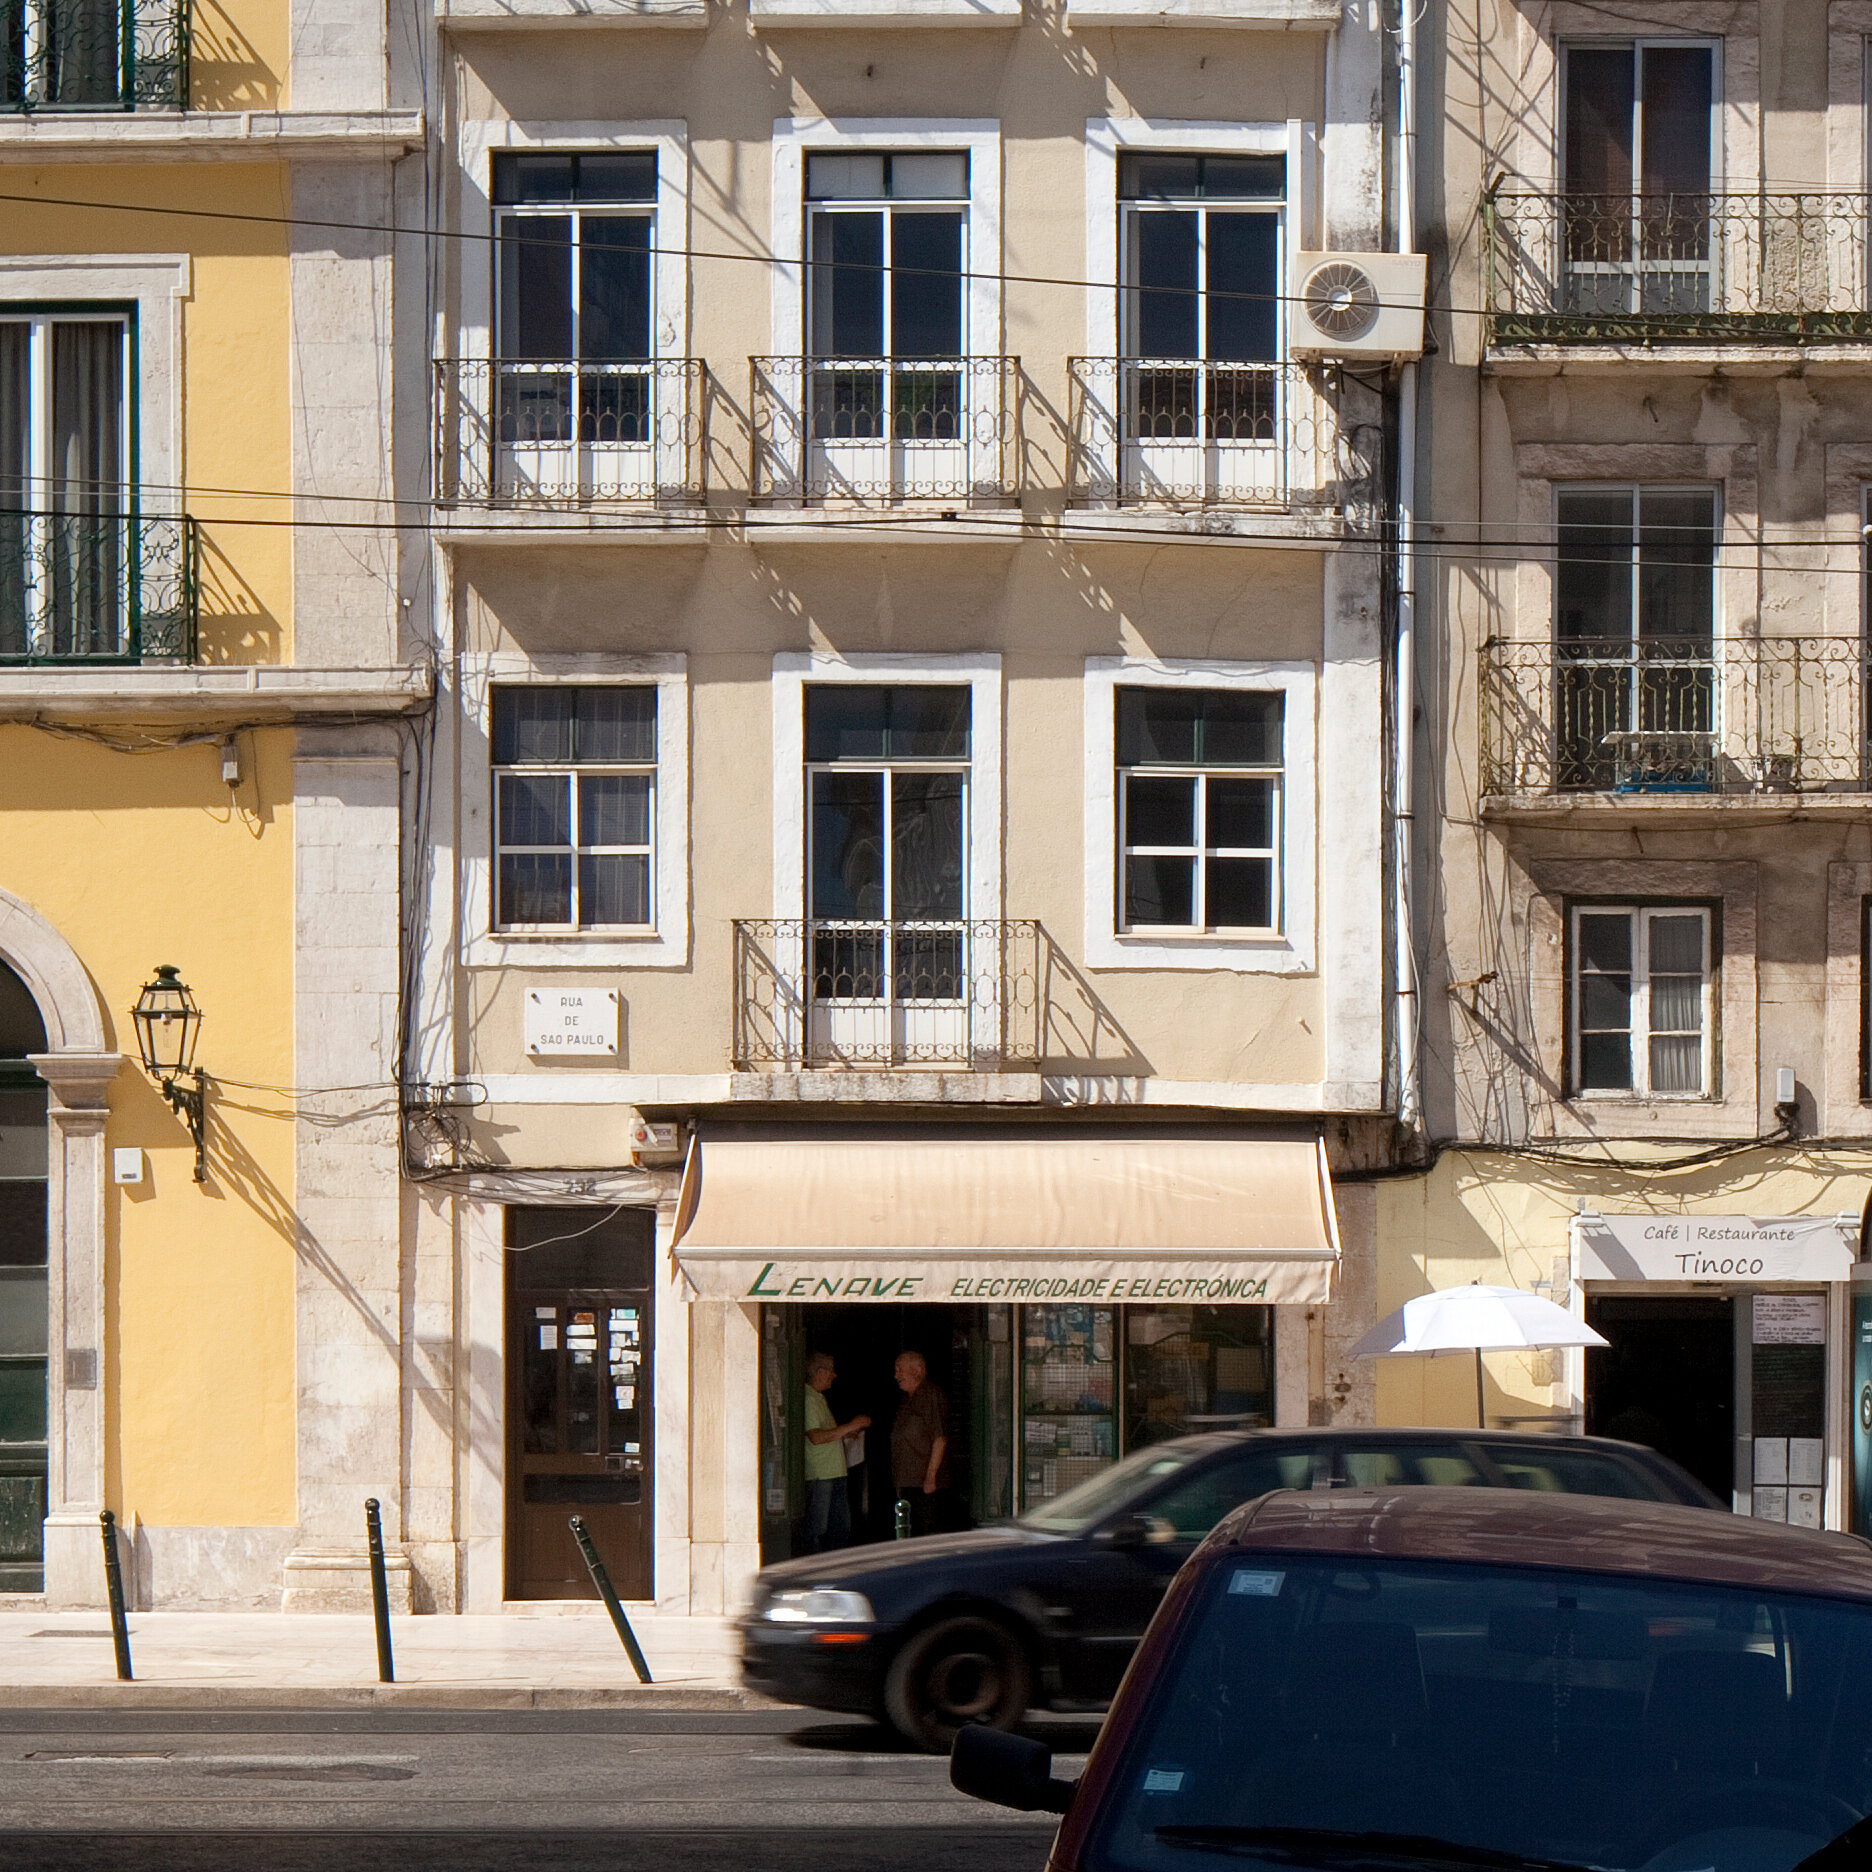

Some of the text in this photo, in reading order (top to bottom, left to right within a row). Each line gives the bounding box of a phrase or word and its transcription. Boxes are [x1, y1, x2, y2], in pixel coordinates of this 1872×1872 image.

[560, 997, 583, 1007] RUA
[564, 1016, 580, 1026] DE
[567, 1034, 604, 1045] PAULO
[1644, 1224, 1678, 1241] Café
[1697, 1226, 1796, 1241] Restaurante
[1674, 1250, 1764, 1275] Tinoco
[950, 1278, 1109, 1297] ELECTRICIDADE
[1110, 1278, 1127, 1297] E
[1128, 1274, 1268, 1298] ELECTRÓNICA
